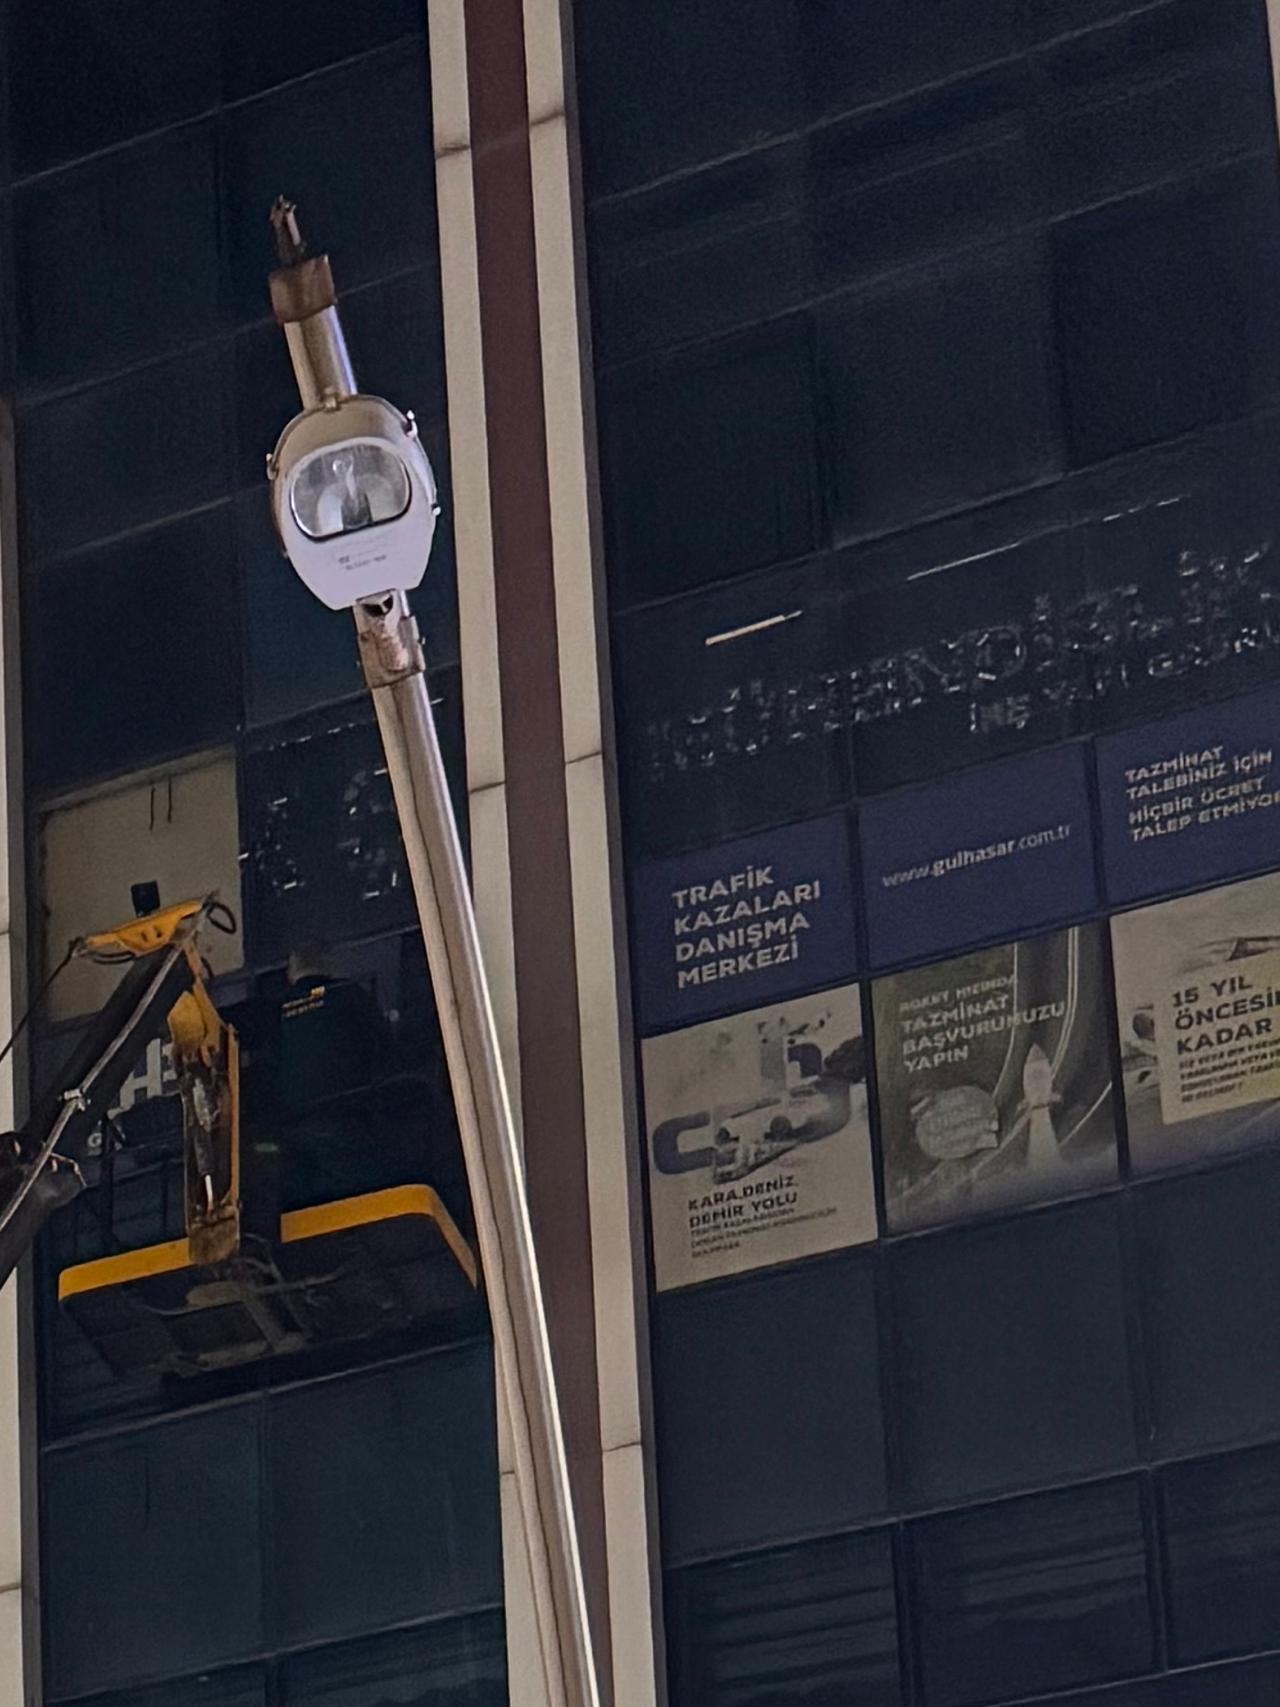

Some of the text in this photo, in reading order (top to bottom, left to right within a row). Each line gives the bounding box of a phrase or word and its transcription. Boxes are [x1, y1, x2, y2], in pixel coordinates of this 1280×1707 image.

[672, 865, 774, 909] TRAFİK
[674, 880, 820, 936] KAZALARI
[676, 912, 810, 963] DANIŞMA
[678, 934, 799, 989] MERKEZİ
[1172, 976, 1253, 1008] 15 YIL
[1177, 1018, 1272, 1055] KADAR
[903, 1046, 969, 1073] YAPIN
